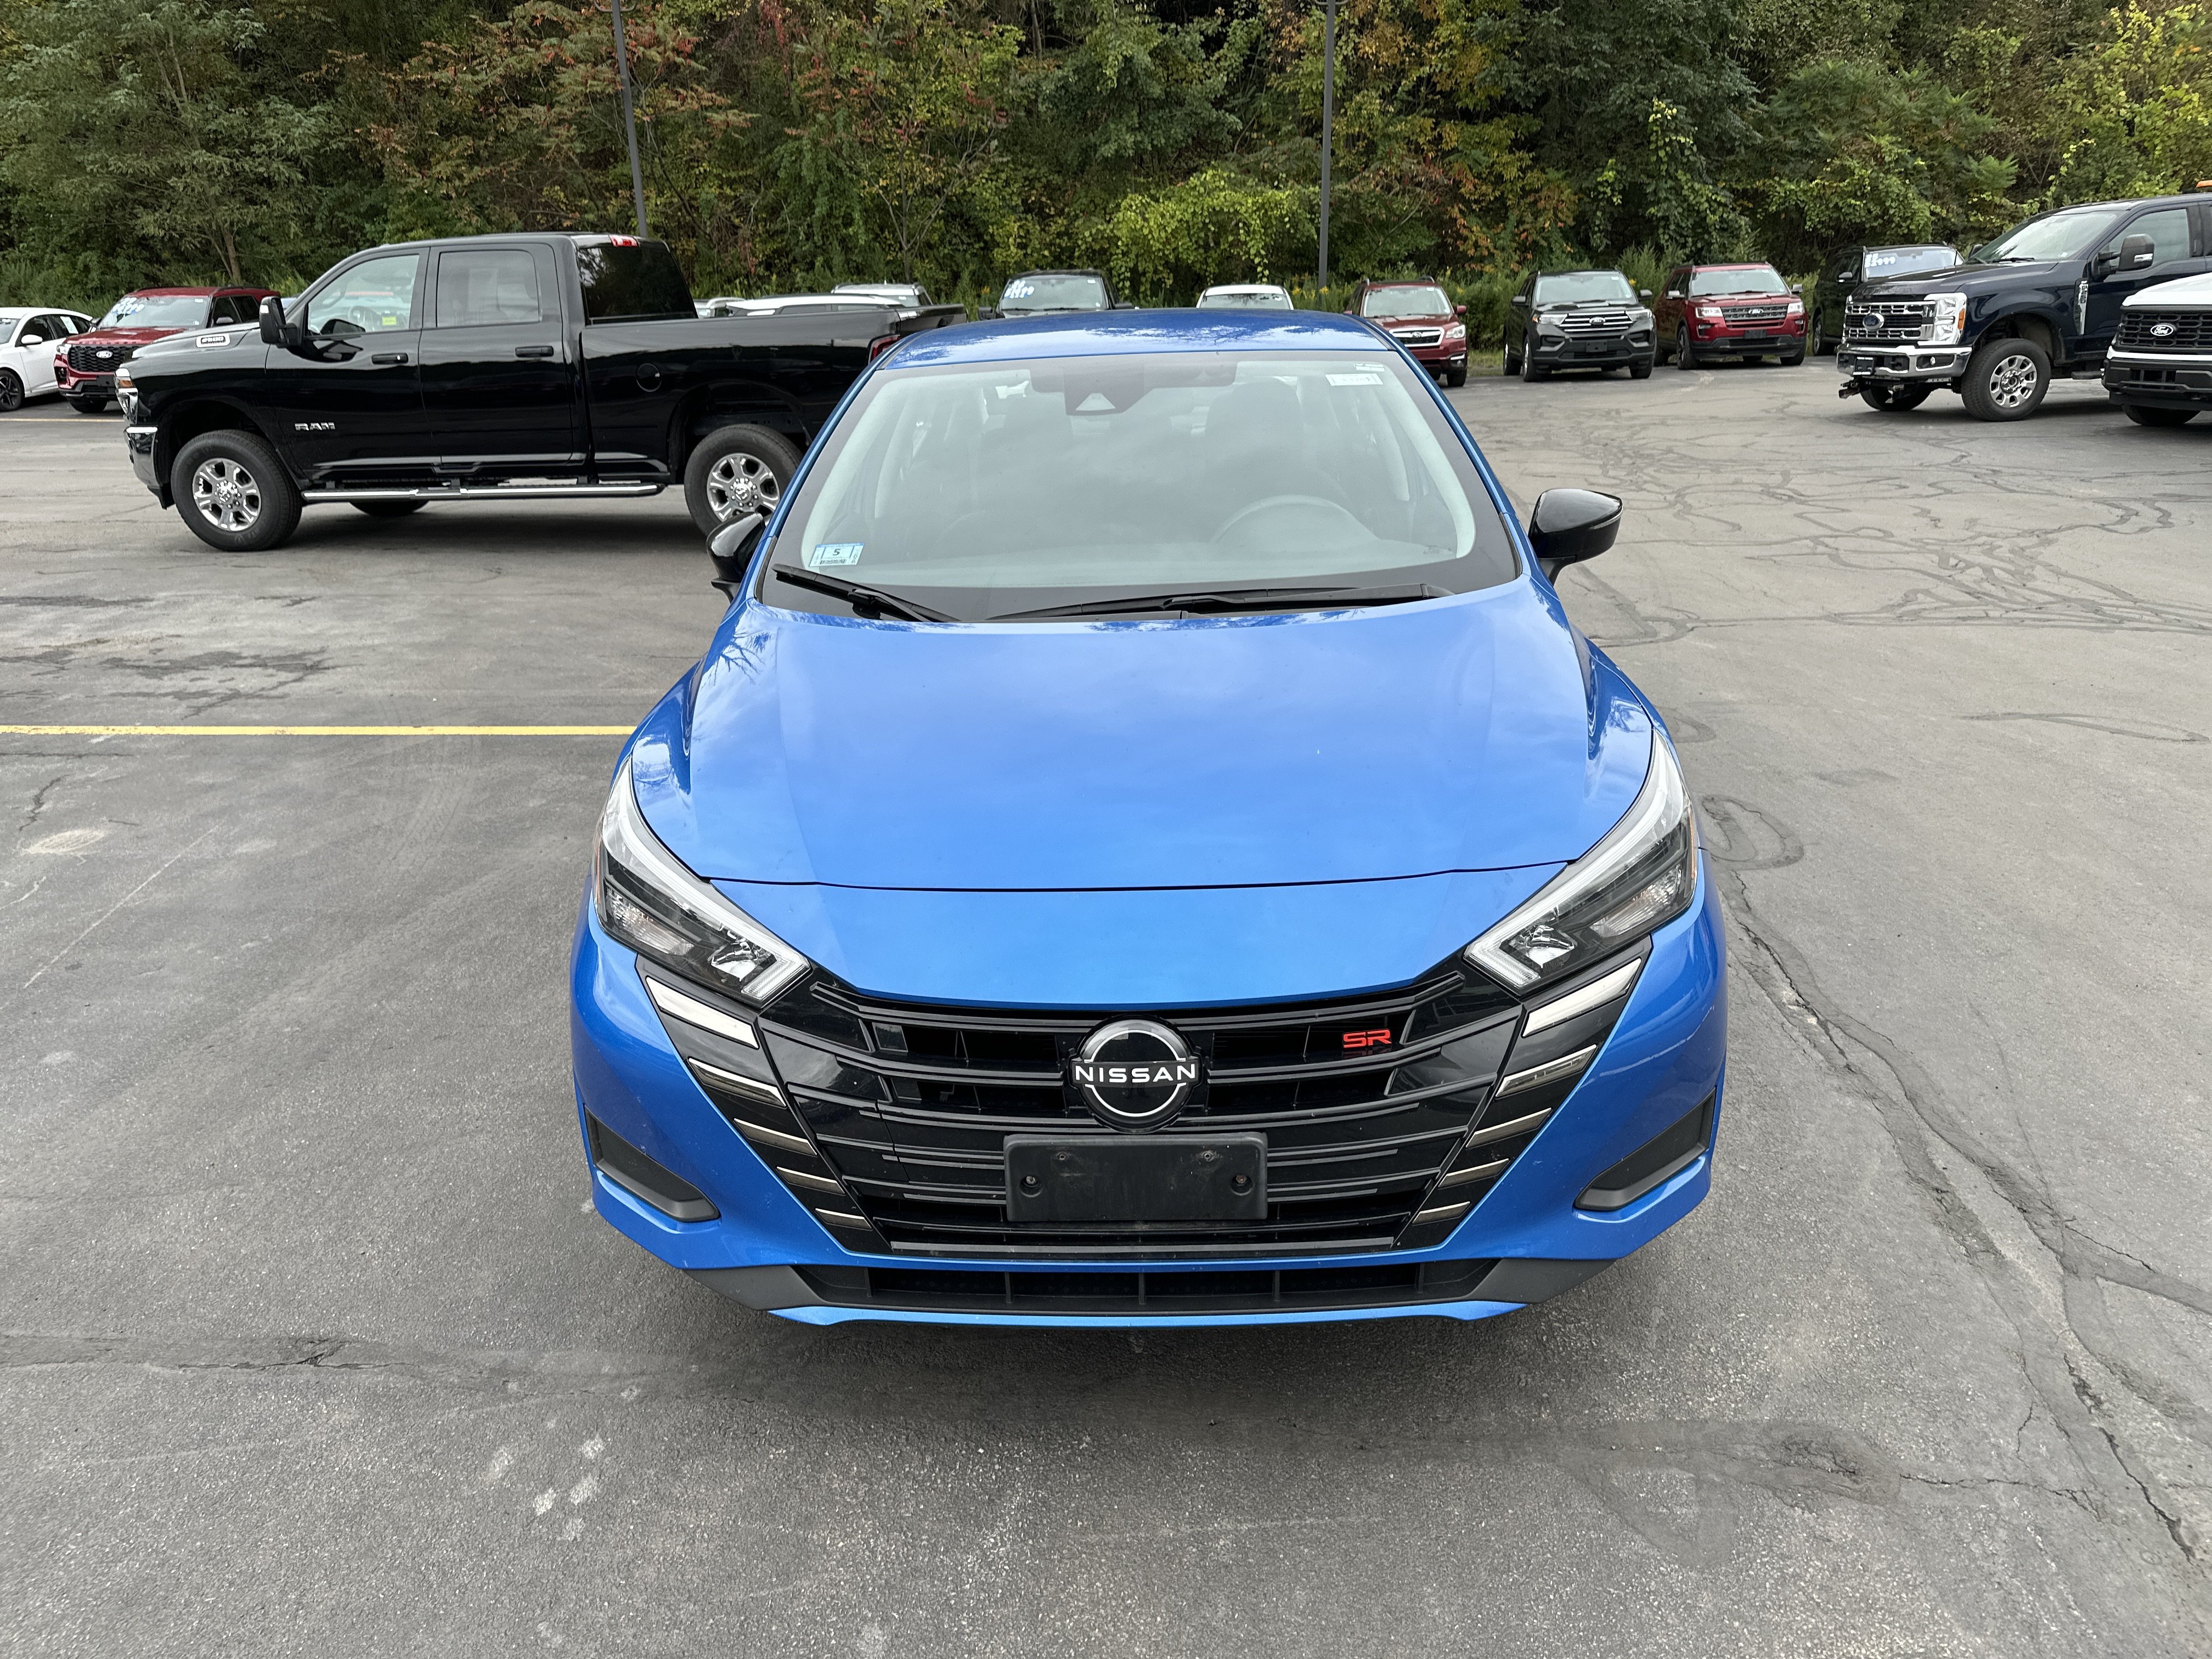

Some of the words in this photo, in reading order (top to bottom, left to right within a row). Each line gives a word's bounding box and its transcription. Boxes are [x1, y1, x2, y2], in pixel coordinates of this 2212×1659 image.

[2153, 325, 2170, 335] Ford
[295, 422, 336, 431] RAM
[832, 548, 841, 556] 5
[1343, 1029, 1392, 1048] SR
[1075, 1063, 1195, 1083] NISSAN
